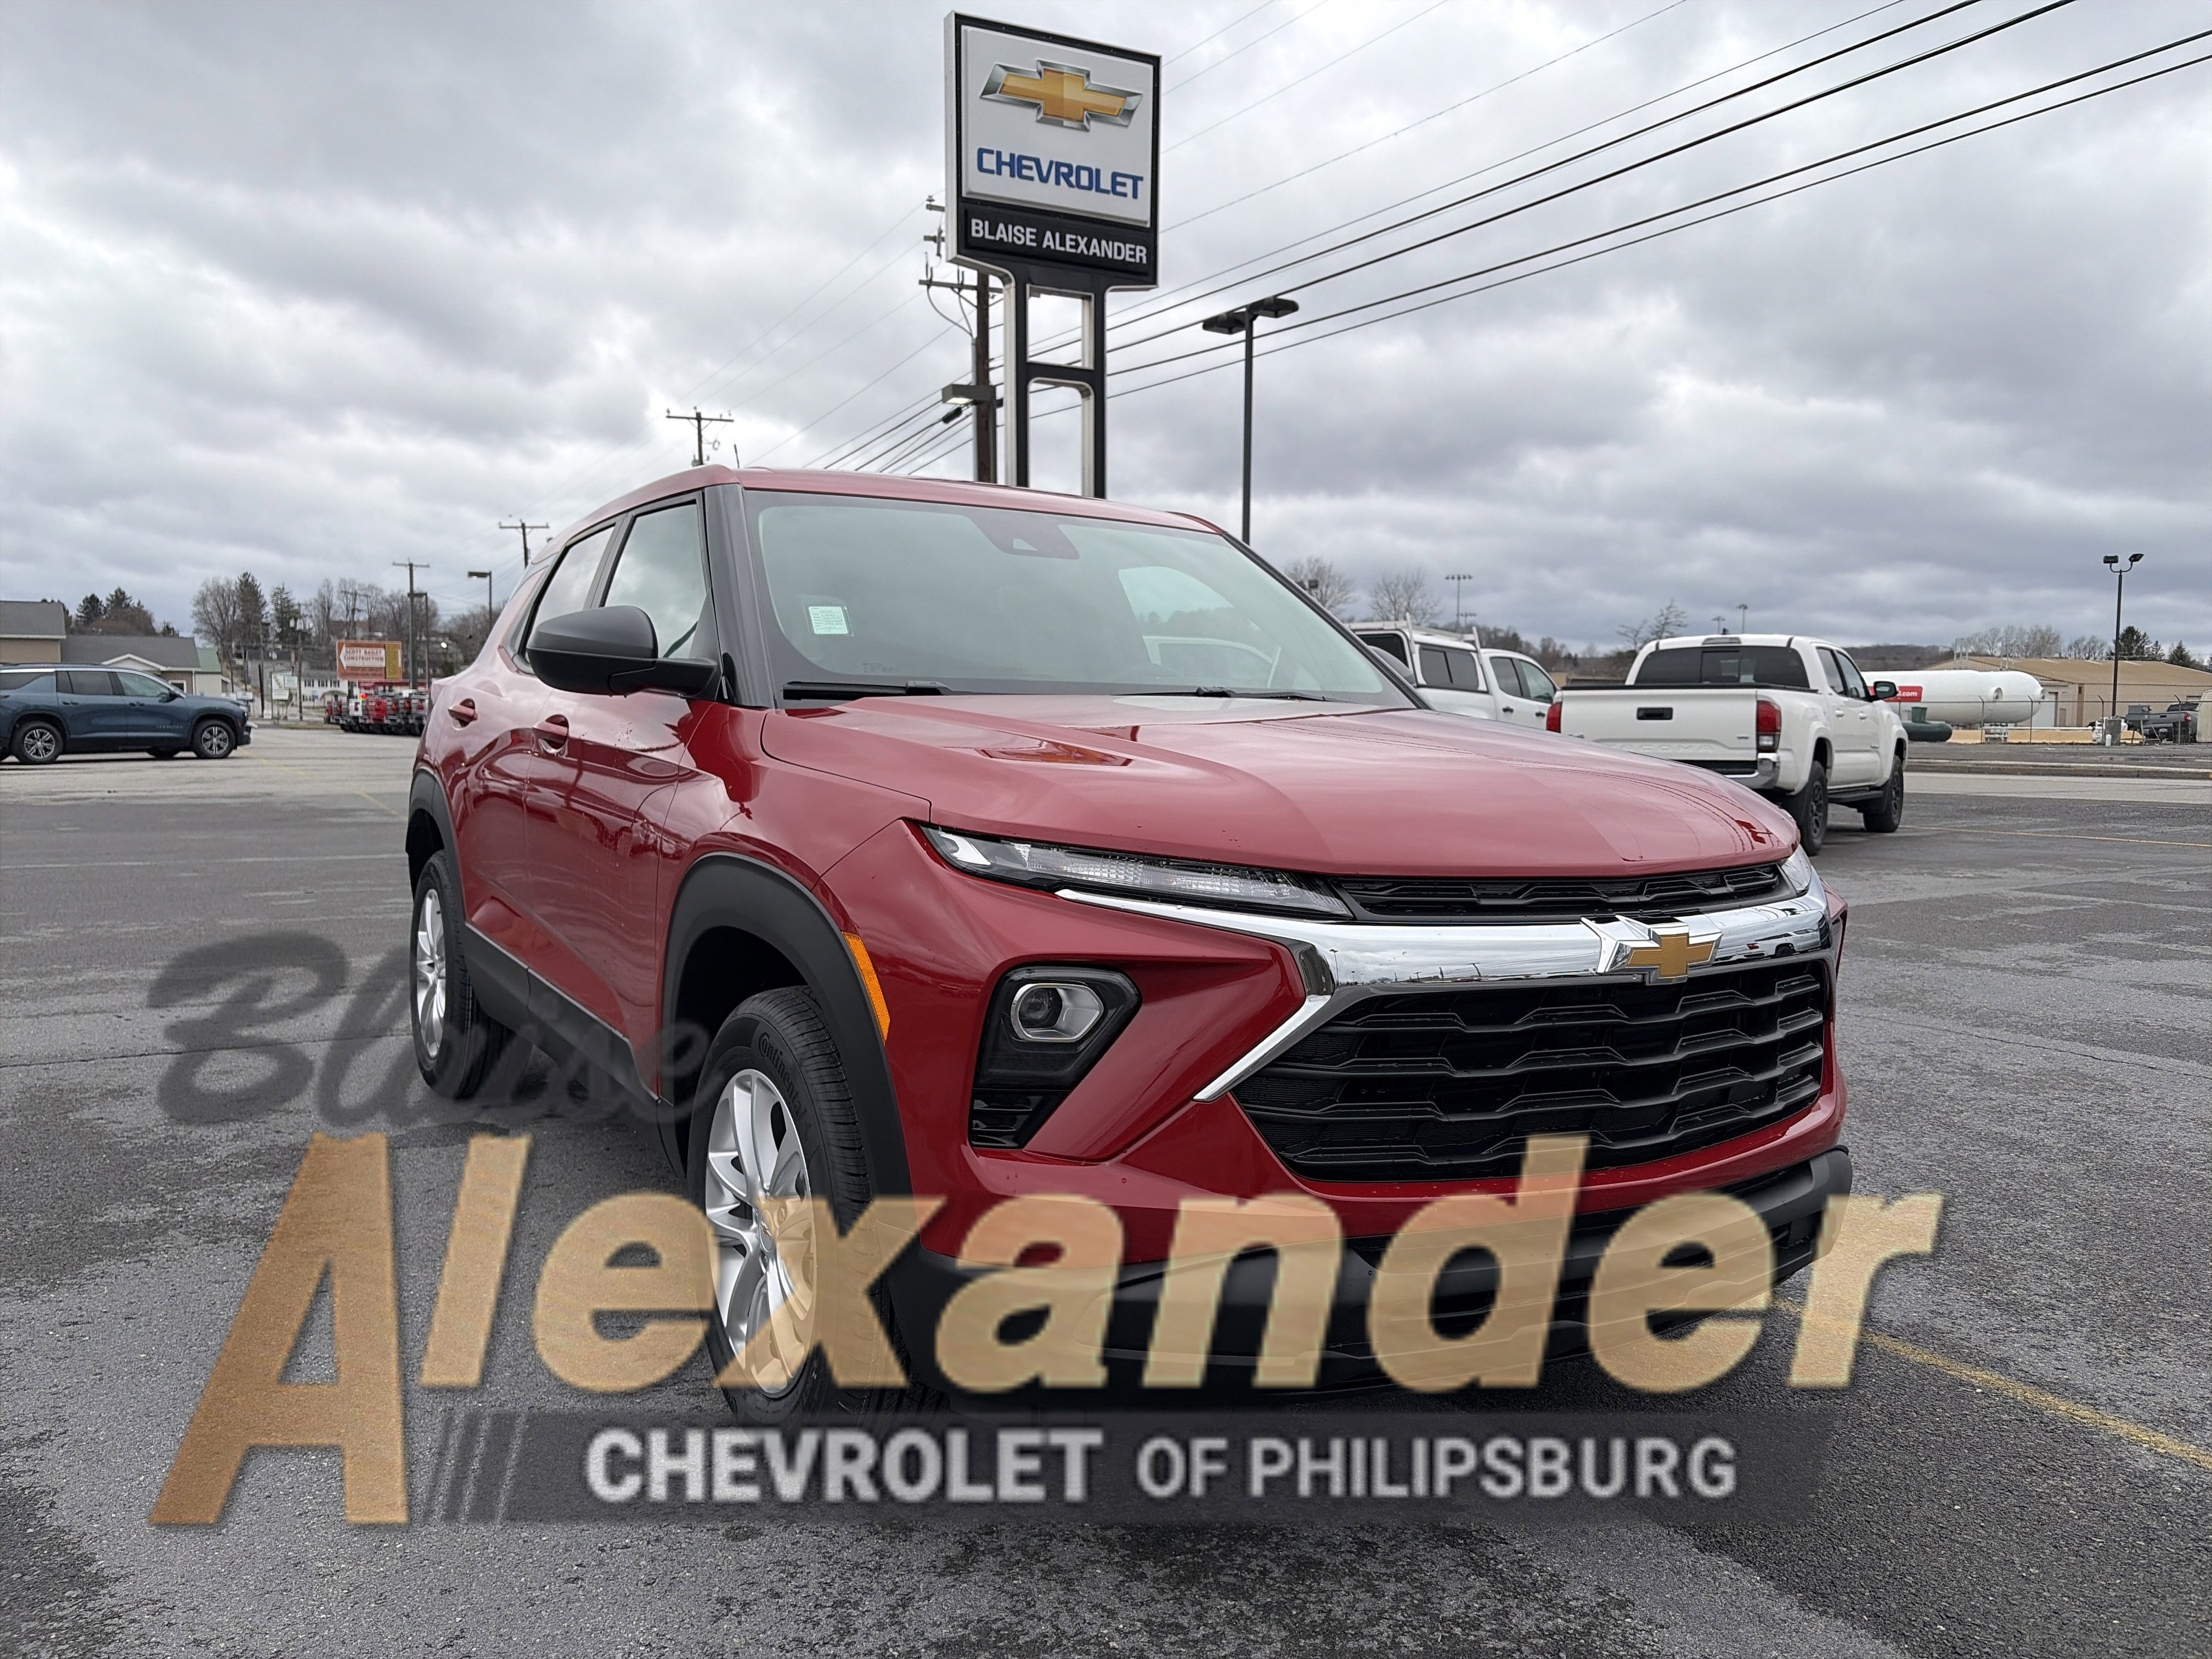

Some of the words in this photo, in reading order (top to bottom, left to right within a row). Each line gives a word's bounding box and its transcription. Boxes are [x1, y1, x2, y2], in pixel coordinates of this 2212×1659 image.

[977, 147, 1144, 199] CHEVROLET
[971, 218, 1037, 247] BLAISE
[1042, 230, 1147, 264] ALEXANDER
[758, 1031, 808, 1117] Continental
